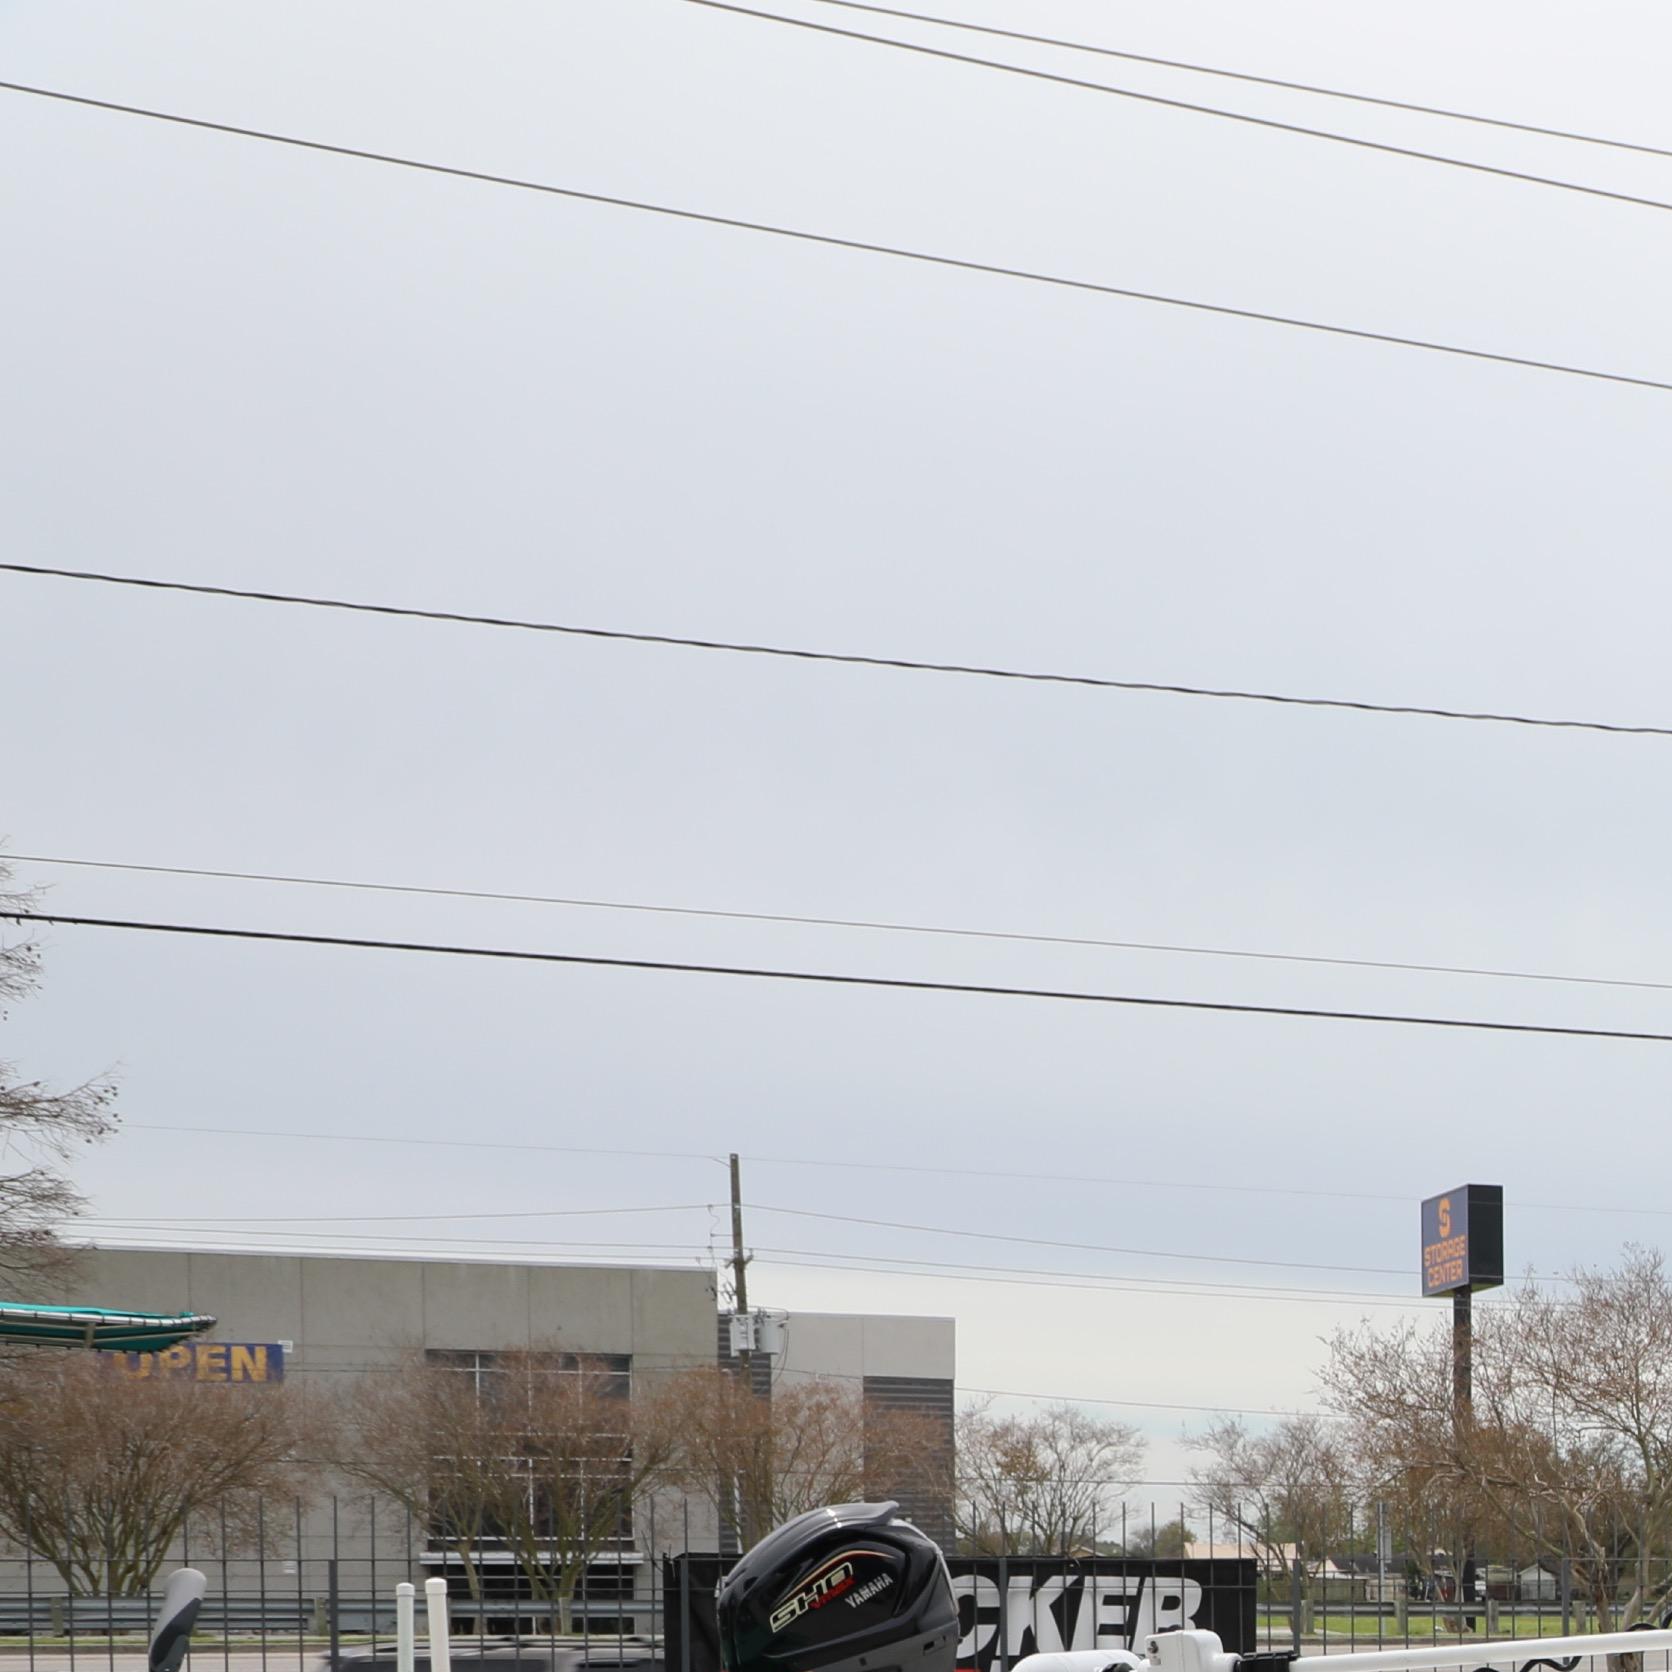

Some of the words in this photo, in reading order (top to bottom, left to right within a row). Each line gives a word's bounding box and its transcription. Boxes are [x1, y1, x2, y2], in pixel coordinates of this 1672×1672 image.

[1424, 1235, 1466, 1267] STORAGE
[1428, 1259, 1463, 1288] CENTER
[113, 1344, 268, 1382] OPEN
[845, 1576, 894, 1608] YAMAHA
[950, 1575, 1202, 1660] CKER
